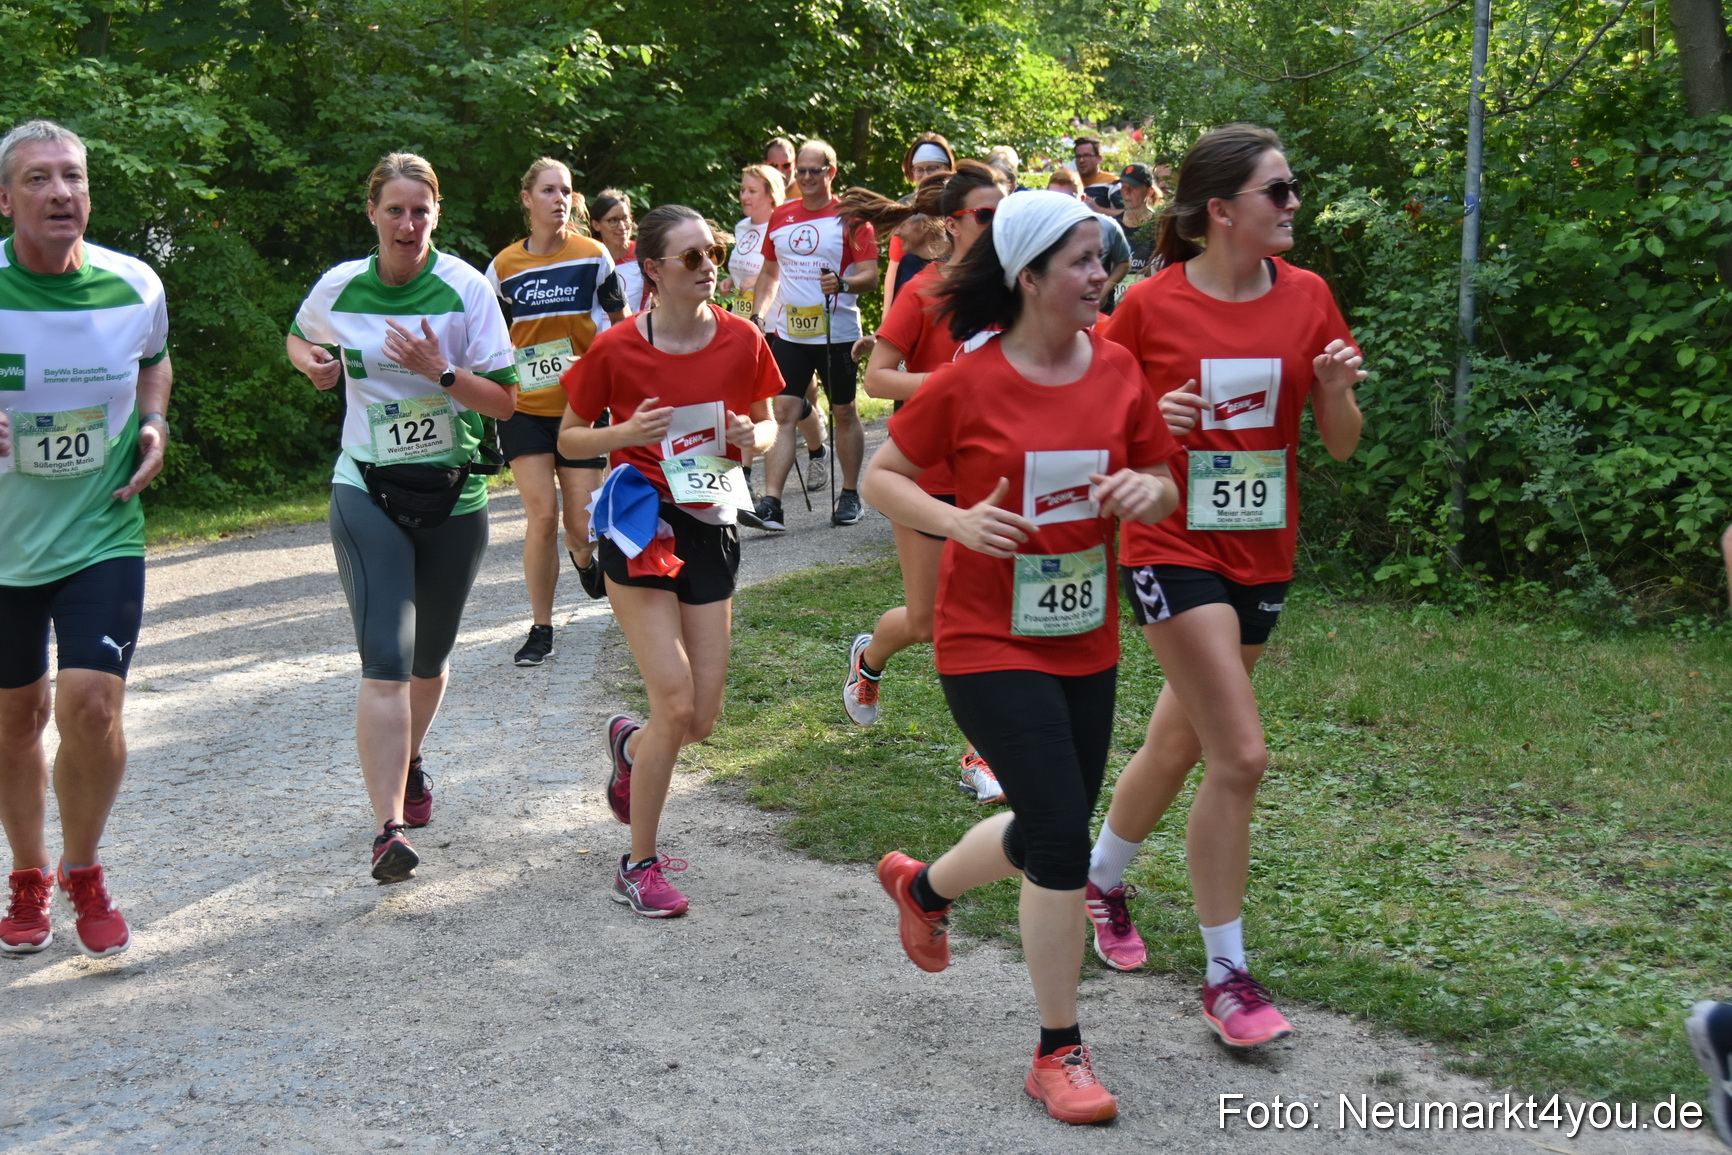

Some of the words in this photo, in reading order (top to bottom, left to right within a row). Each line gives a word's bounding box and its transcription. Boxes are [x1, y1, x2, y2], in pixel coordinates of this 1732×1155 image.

[525, 284, 579, 300] Fischer
[531, 296, 575, 306] AUTOMOBILE
[790, 316, 819, 329] 1907
[44, 368, 71, 377] BayWa
[72, 367, 108, 375] Baustoffe
[527, 356, 562, 378] 766
[84, 375, 105, 384] gutes
[388, 418, 437, 446] 122
[38, 432, 90, 461] 120
[387, 445, 414, 454] Weidner
[415, 440, 444, 450] Susanne
[33, 460, 75, 470] Süßenguth
[76, 457, 95, 465] Mario
[687, 472, 732, 493] 526
[1212, 480, 1267, 508] 519
[1038, 580, 1092, 613] 488
